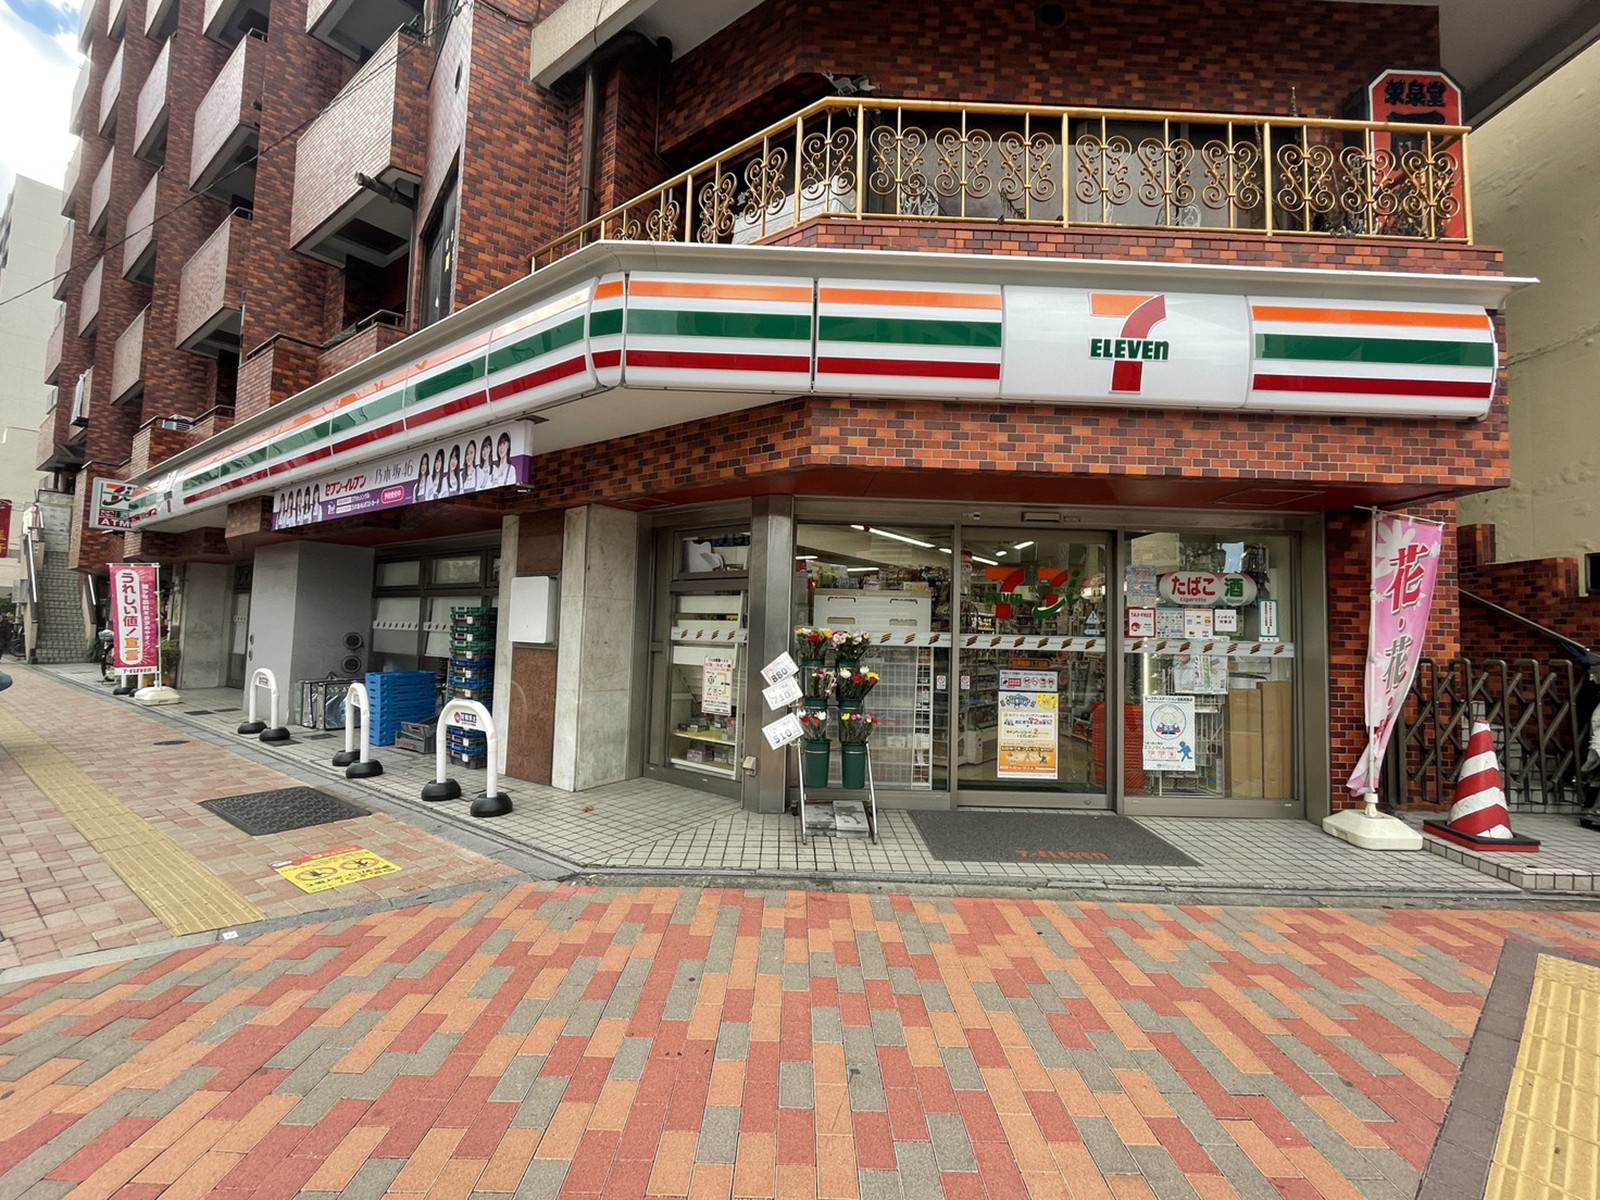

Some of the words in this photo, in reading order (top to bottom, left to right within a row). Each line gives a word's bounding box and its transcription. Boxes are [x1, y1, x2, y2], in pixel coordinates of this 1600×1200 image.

[375, 459, 413, 485] 乃木坂46
[101, 518, 130, 528] ATM
[1171, 576, 1216, 596] たばこ
[1224, 577, 1244, 597] 酒
[771, 691, 791, 704] 710
[773, 729, 793, 744] 510
